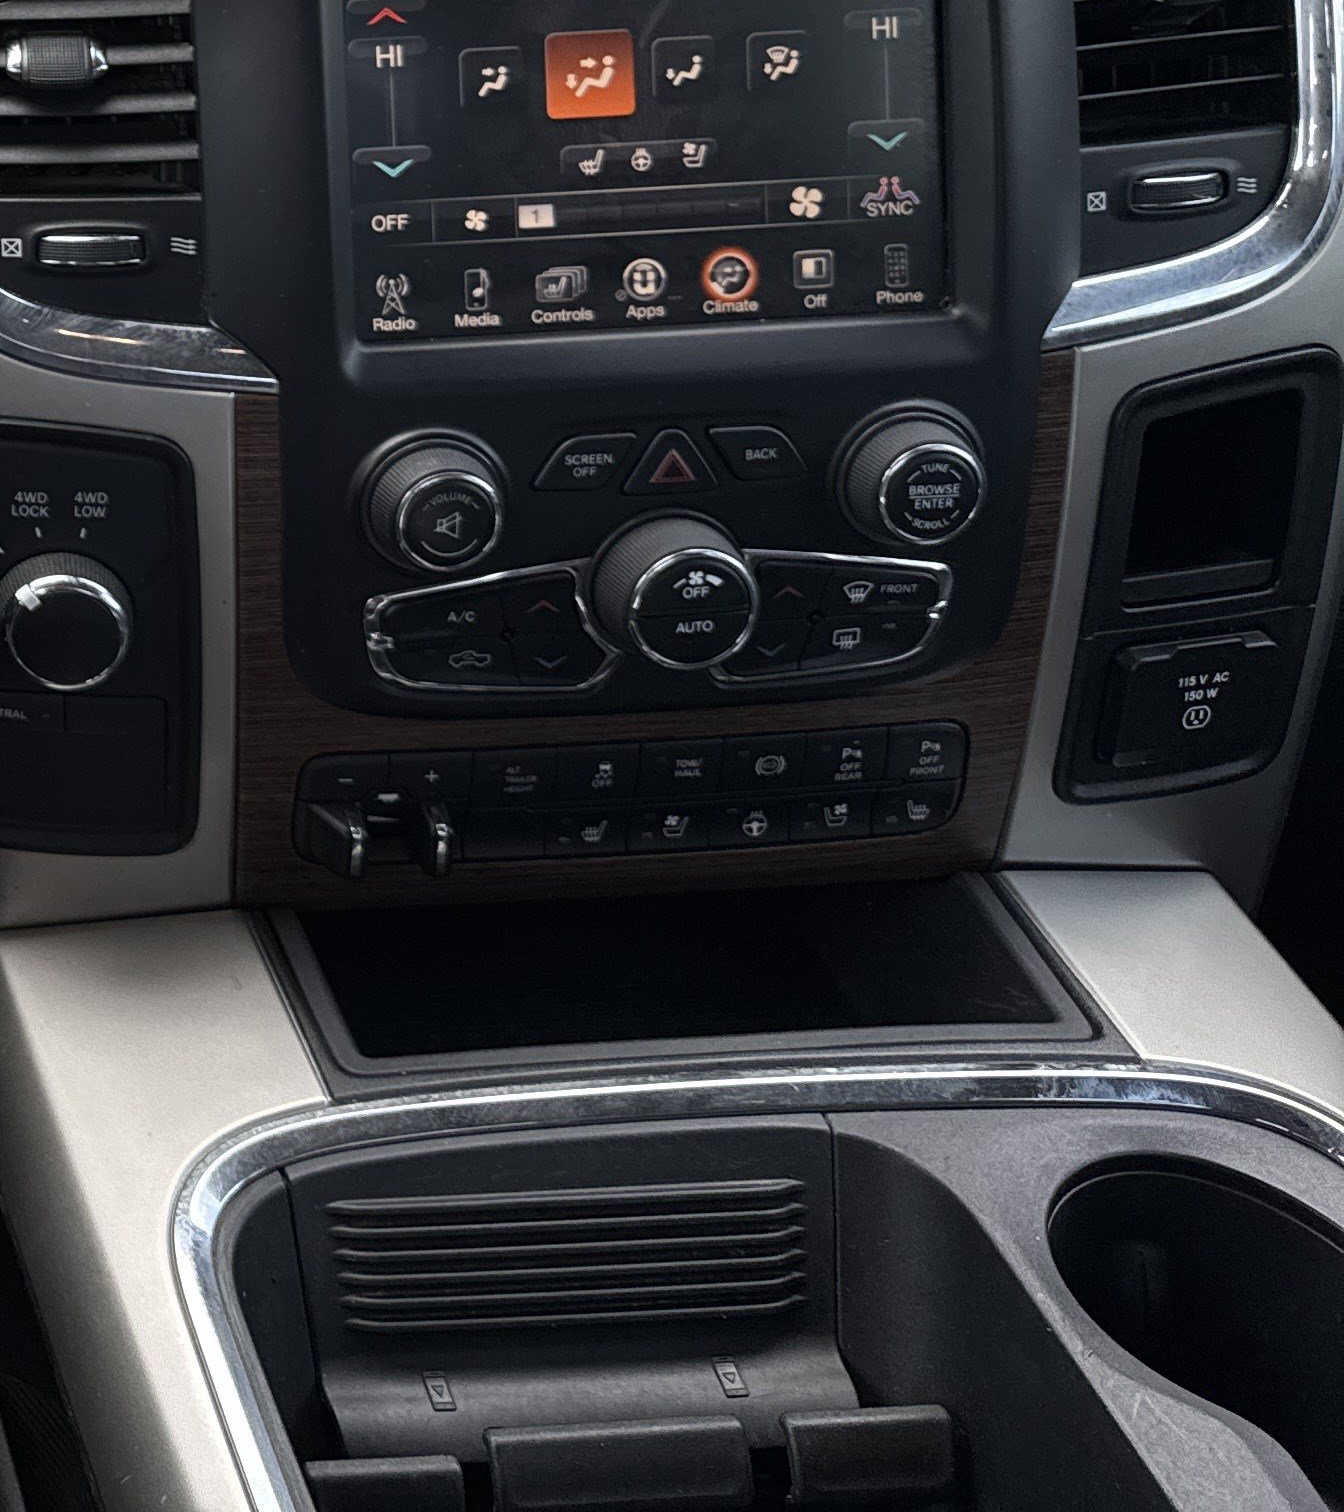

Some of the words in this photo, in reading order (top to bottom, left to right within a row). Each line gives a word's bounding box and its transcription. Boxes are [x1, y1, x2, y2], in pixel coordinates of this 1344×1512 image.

[871, 15, 899, 41] HI
[375, 44, 403, 69] HI
[531, 209, 540, 225] 1
[865, 200, 915, 219] SYNC
[371, 213, 412, 233] OFF
[803, 294, 829, 310] Off
[875, 290, 924, 305] Phone
[625, 304, 666, 322] Apps
[702, 298, 760, 315] Climate
[454, 312, 502, 328] Media
[531, 307, 594, 324] Controls
[372, 316, 417, 332] Radio
[564, 453, 613, 466] SCREEN
[744, 446, 779, 463] BACK
[572, 467, 599, 478] OFF
[921, 462, 950, 474] TUNE
[908, 483, 961, 496] BROWSE
[14, 491, 49, 504] 4WD
[74, 491, 109, 504] 4WD
[429, 491, 472, 506] VOLUME
[914, 497, 954, 510] ENTER
[11, 505, 50, 518] LOCK
[74, 505, 108, 519] LOW
[911, 517, 951, 530] SCROLL
[681, 584, 710, 600] OFF
[879, 582, 919, 597] FRONT
[447, 609, 477, 623] A/C
[675, 618, 715, 635] AUTO
[1177, 675, 1198, 688] 115
[1199, 673, 1210, 686] V
[1212, 671, 1230, 683] AC
[1184, 689, 1204, 702] 150
[1206, 687, 1219, 699] W
[840, 762, 863, 772] OFF
[918, 754, 941, 766] OFF
[908, 764, 945, 776] FRONT
